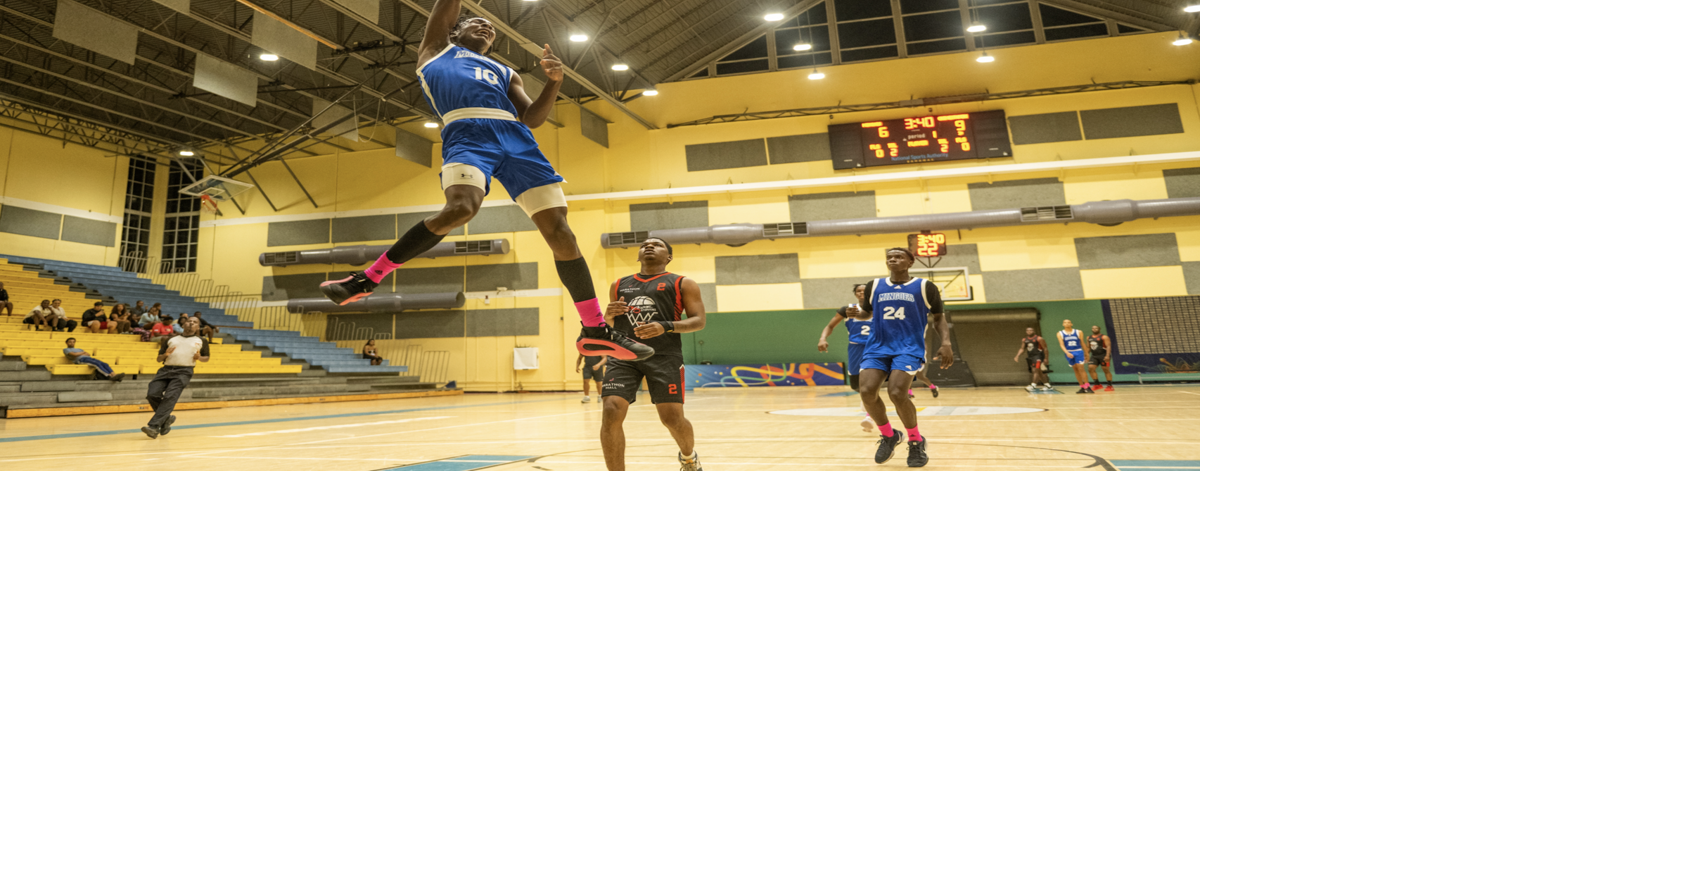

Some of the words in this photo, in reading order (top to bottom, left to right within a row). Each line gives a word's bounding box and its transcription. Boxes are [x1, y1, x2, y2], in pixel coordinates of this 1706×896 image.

[473, 67, 498, 84] 10
[904, 116, 936, 130] 3:40
[954, 120, 966, 130] 9
[878, 126, 890, 138] 6
[940, 144, 949, 153] 2
[961, 142, 971, 152] 0
[875, 149, 885, 158] 0
[889, 148, 899, 157] 2
[917, 234, 946, 244] 3:40
[917, 243, 939, 256] 22
[656, 282, 666, 290] 2
[883, 306, 906, 320] 24
[668, 384, 678, 394] 2
